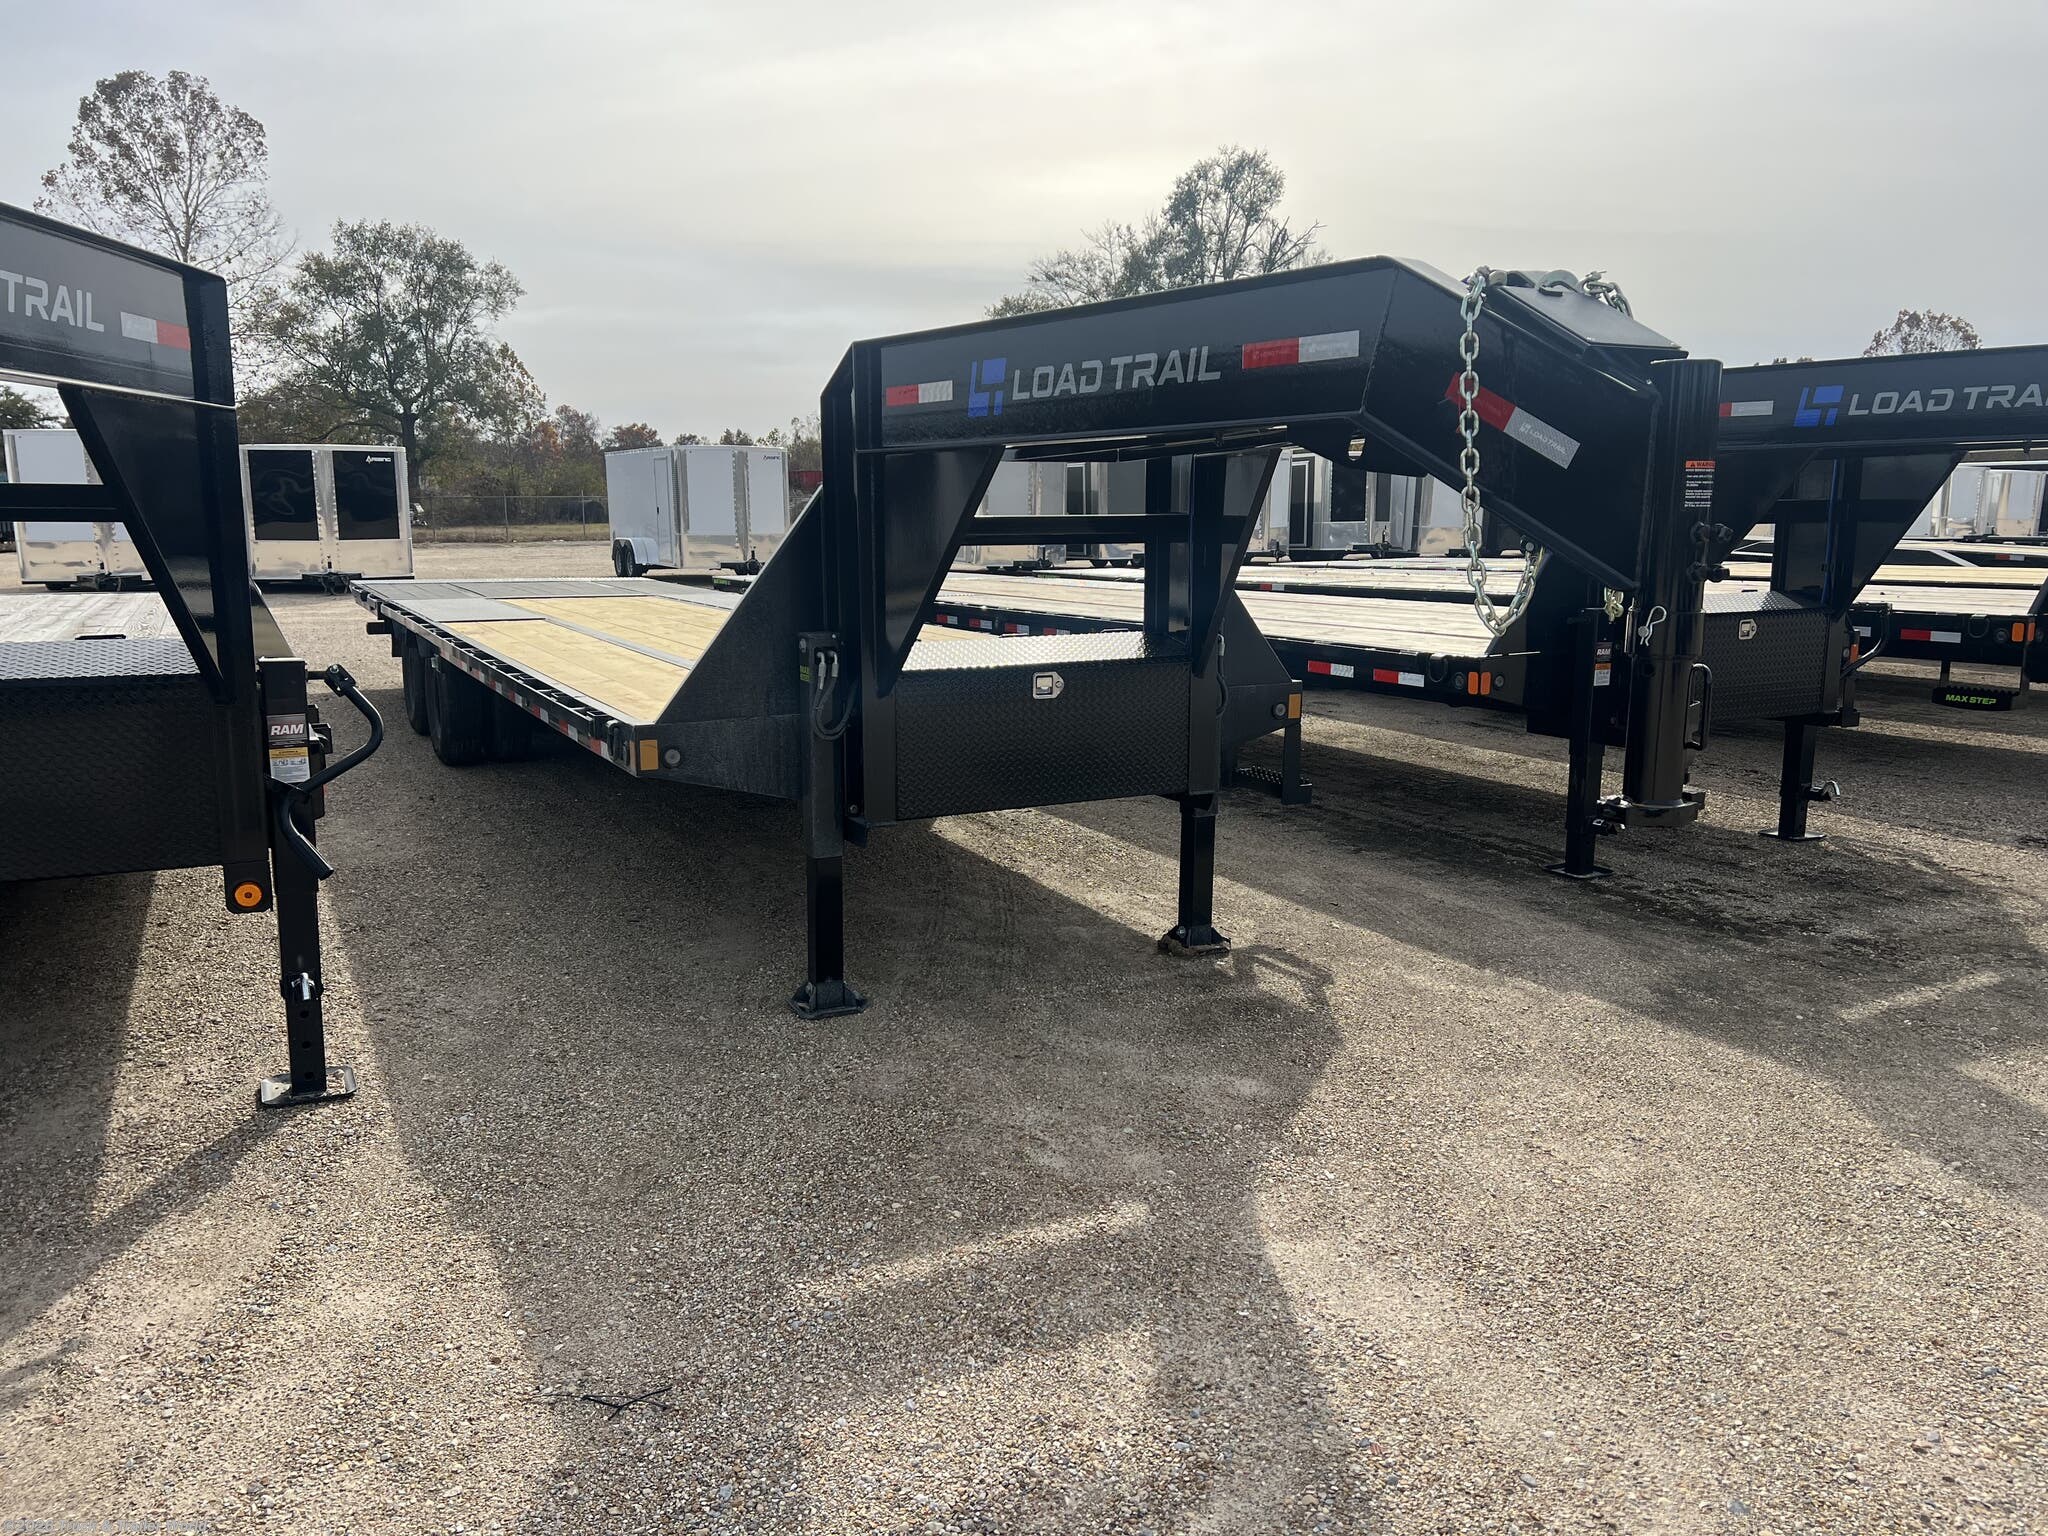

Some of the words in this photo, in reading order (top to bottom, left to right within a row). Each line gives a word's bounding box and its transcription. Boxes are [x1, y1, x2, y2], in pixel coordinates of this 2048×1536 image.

[0, 269, 105, 333] TRAIL
[1012, 359, 1104, 401] LOAD
[1111, 345, 1222, 390] TRAIL
[1848, 388, 1955, 416] LOAD
[1963, 383, 2048, 410] TRA
[1945, 694, 1969, 703] MAX
[1969, 696, 1997, 705] STEP
[271, 723, 305, 736] RAM
